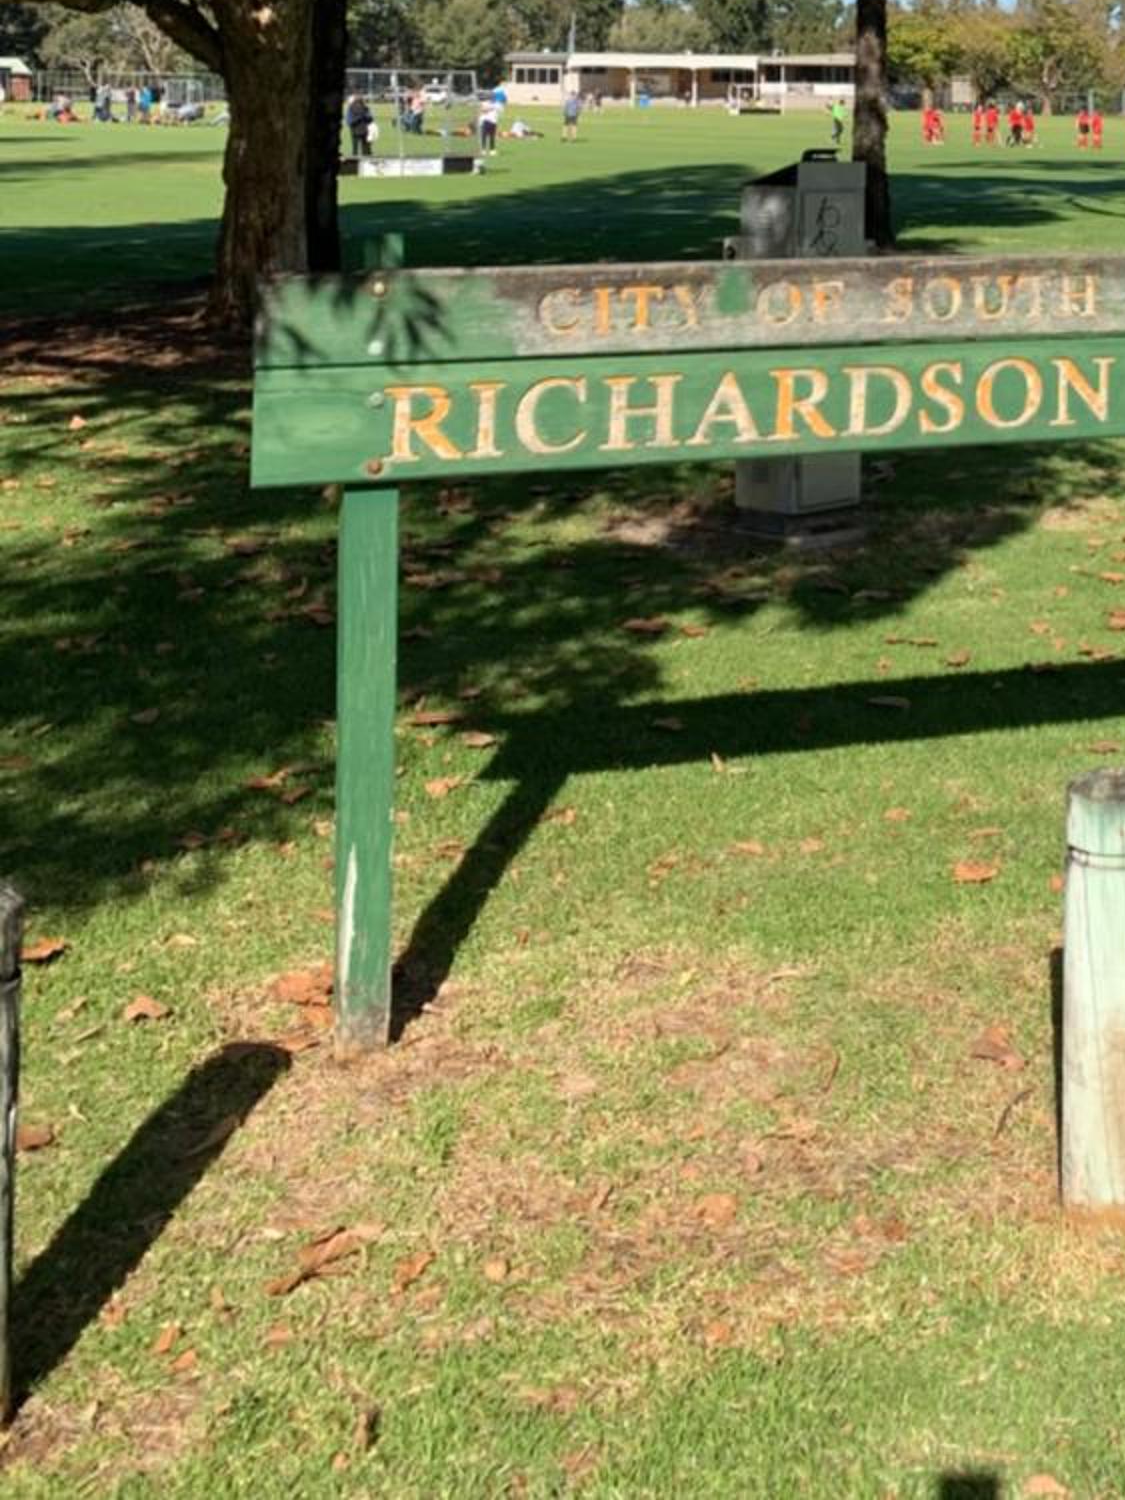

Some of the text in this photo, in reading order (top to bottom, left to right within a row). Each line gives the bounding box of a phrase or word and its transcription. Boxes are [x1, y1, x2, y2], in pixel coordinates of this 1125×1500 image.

[538, 282, 708, 335] CITY
[757, 279, 846, 325] OF
[879, 271, 1099, 323] SOUTH
[384, 357, 1116, 464] RICHARDSON
